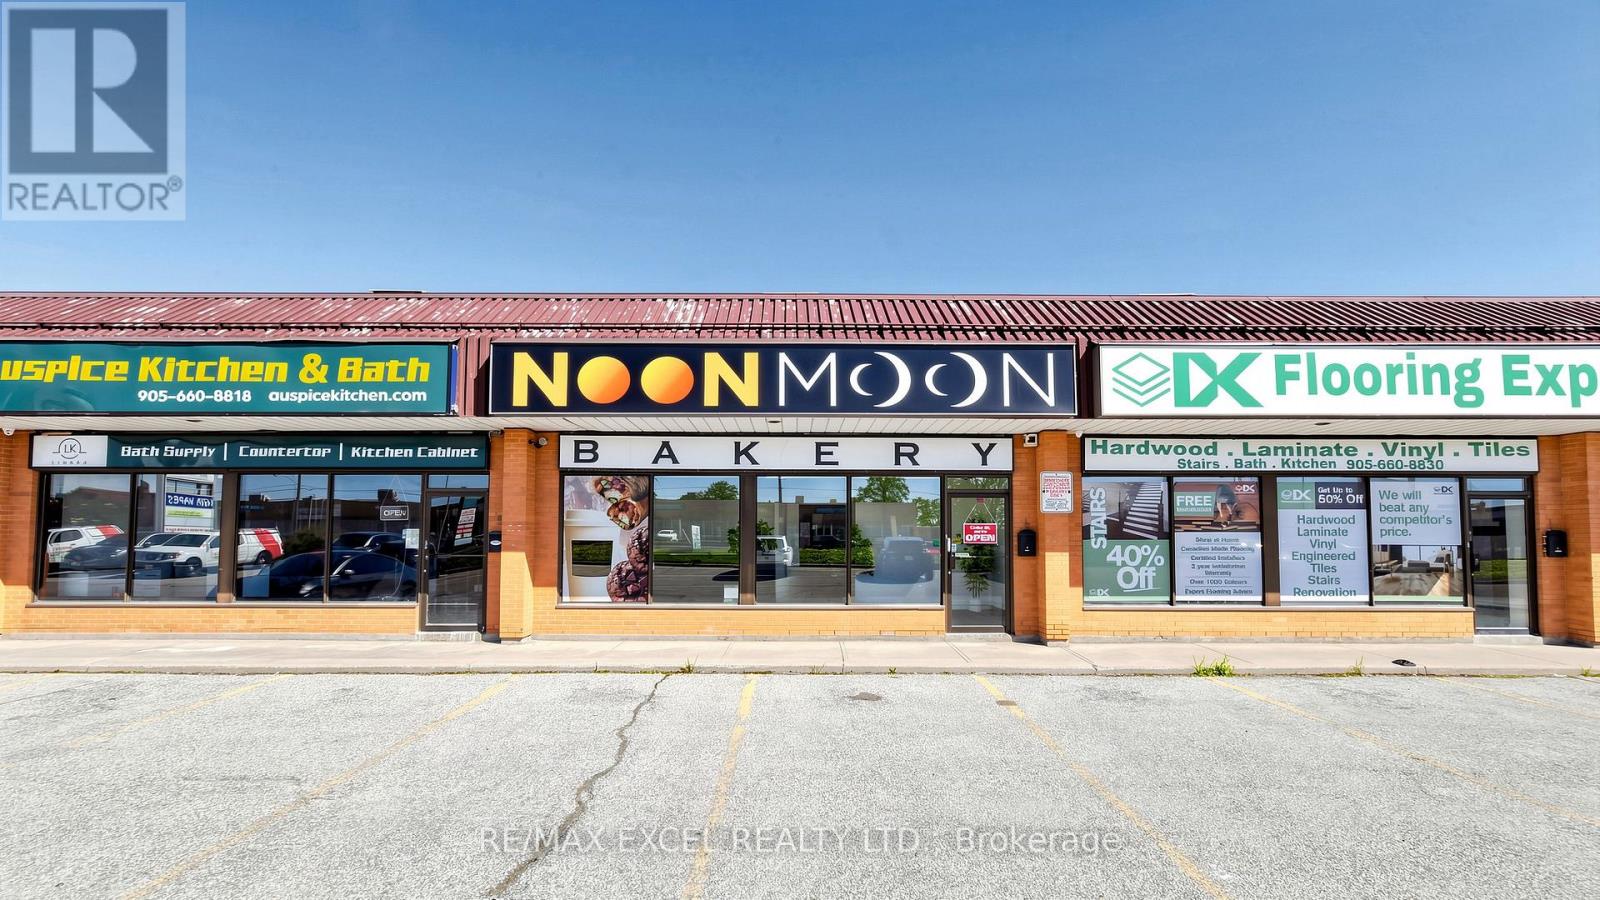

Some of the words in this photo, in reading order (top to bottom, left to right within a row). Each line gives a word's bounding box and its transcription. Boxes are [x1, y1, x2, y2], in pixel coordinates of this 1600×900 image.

[137, 356, 288, 382] Kitchen
[299, 353, 329, 384] &
[337, 357, 431, 382] Bath
[1274, 352, 1485, 409] Flooring
[1501, 354, 1599, 409] Exp
[137, 389, 252, 402] 905-660-8818
[268, 388, 428, 404] auspicekitchen.com
[120, 445, 160, 457] Bath
[163, 445, 216, 458] Supply
[238, 446, 332, 458] Countertop
[350, 446, 414, 458] Kitchen
[1091, 440, 1218, 456] Hardwood
[1242, 442, 1359, 457] Laminate
[1381, 442, 1444, 460] Vinyl
[1468, 442, 1530, 457] Tiles
[1177, 458, 1220, 470] Stairs
[1234, 458, 1267, 469] Bath
[1281, 458, 1337, 469] Kitchen
[1346, 459, 1444, 470] 905-660-8830
[1176, 495, 1212, 506] FREE
[1346, 494, 1364, 504] Off
[1379, 490, 1398, 500] We
[1402, 490, 1422, 500] will
[383, 509, 406, 517] OPEN
[1379, 502, 1405, 512] beat
[1409, 504, 1429, 515] any
[1090, 487, 1108, 549] STAIRS
[1297, 514, 1356, 525] Hardwood
[1380, 514, 1453, 526] competitor's
[1297, 526, 1349, 537] Laminate
[1380, 526, 1412, 538] price.
[1310, 538, 1337, 550] Vinyl
[1106, 545, 1164, 567] 40%
[1292, 551, 1356, 563] Engineered
[1310, 563, 1337, 573] Tiles
[1117, 566, 1156, 589] Off
[1308, 575, 1341, 585] Stairs
[1293, 587, 1357, 597] Renovation
